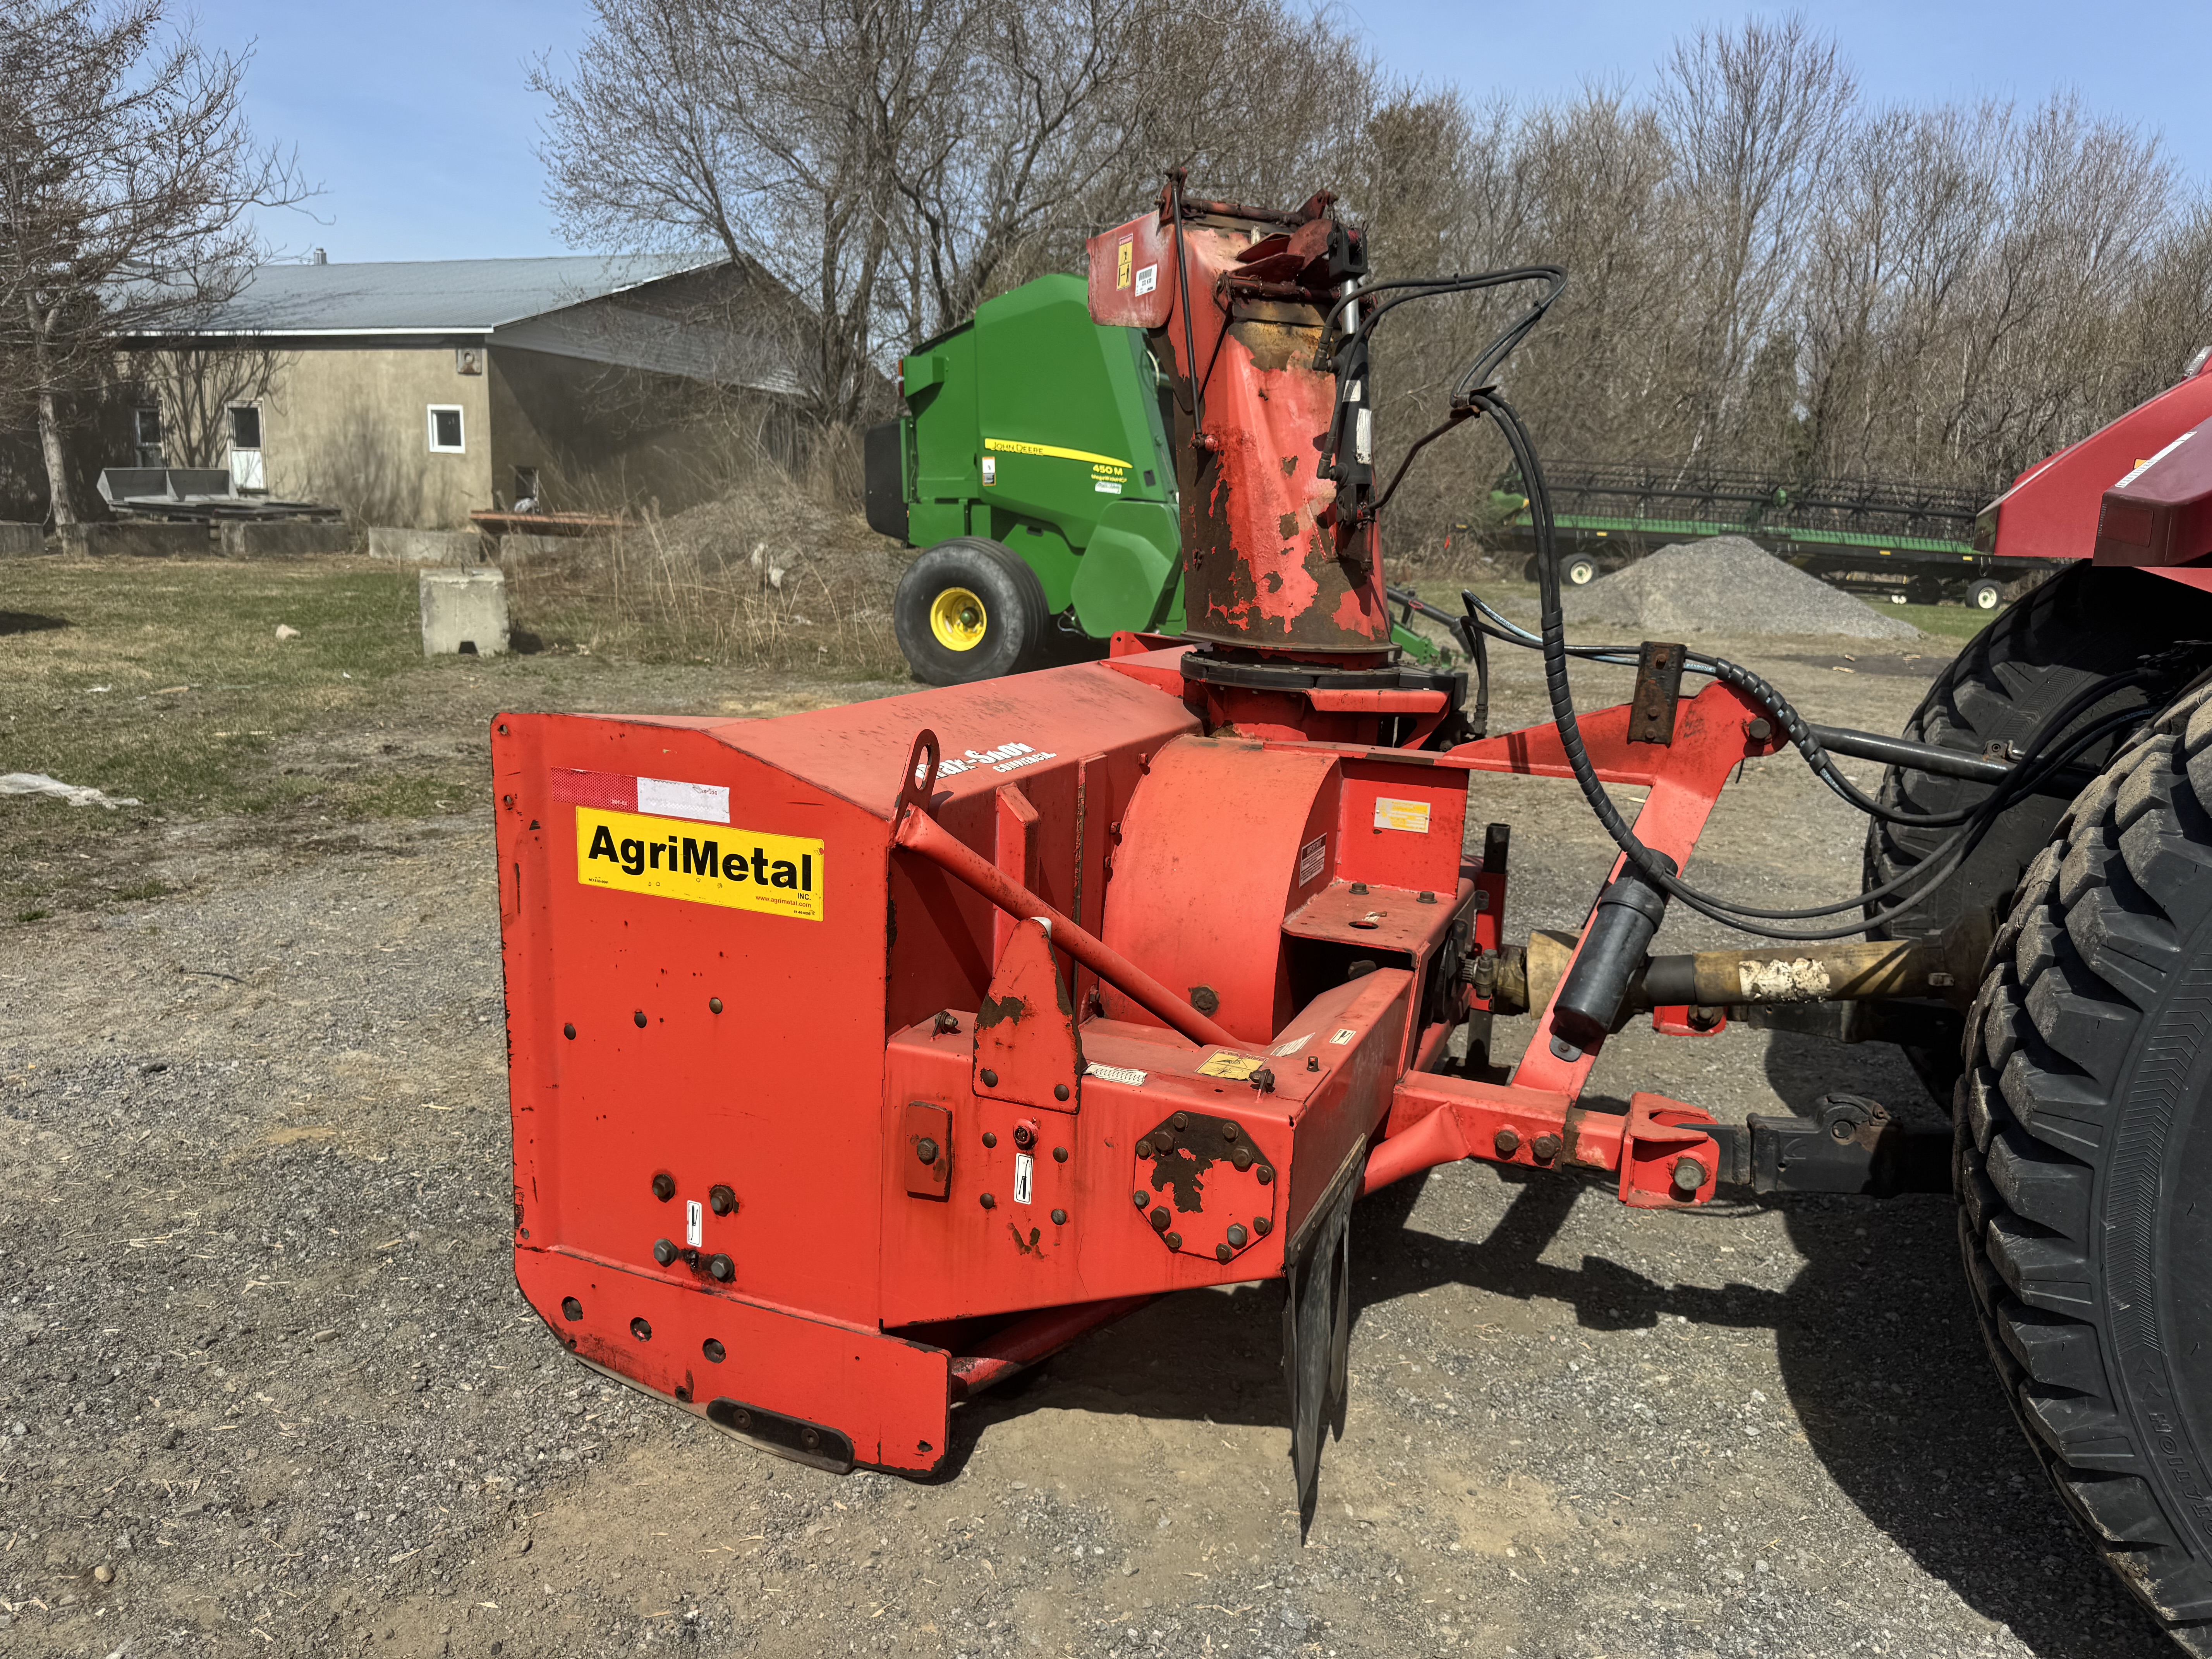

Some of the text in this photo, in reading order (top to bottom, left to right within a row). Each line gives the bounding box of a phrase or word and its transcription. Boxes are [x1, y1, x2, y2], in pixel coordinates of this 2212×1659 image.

[992, 442, 1044, 455] JOHN DEERE
[1093, 464, 1123, 476] 450 M
[588, 824, 812, 891] AgriMetal
[756, 895, 811, 908] www.agrimetal.com
[798, 892, 811, 900] INC.
